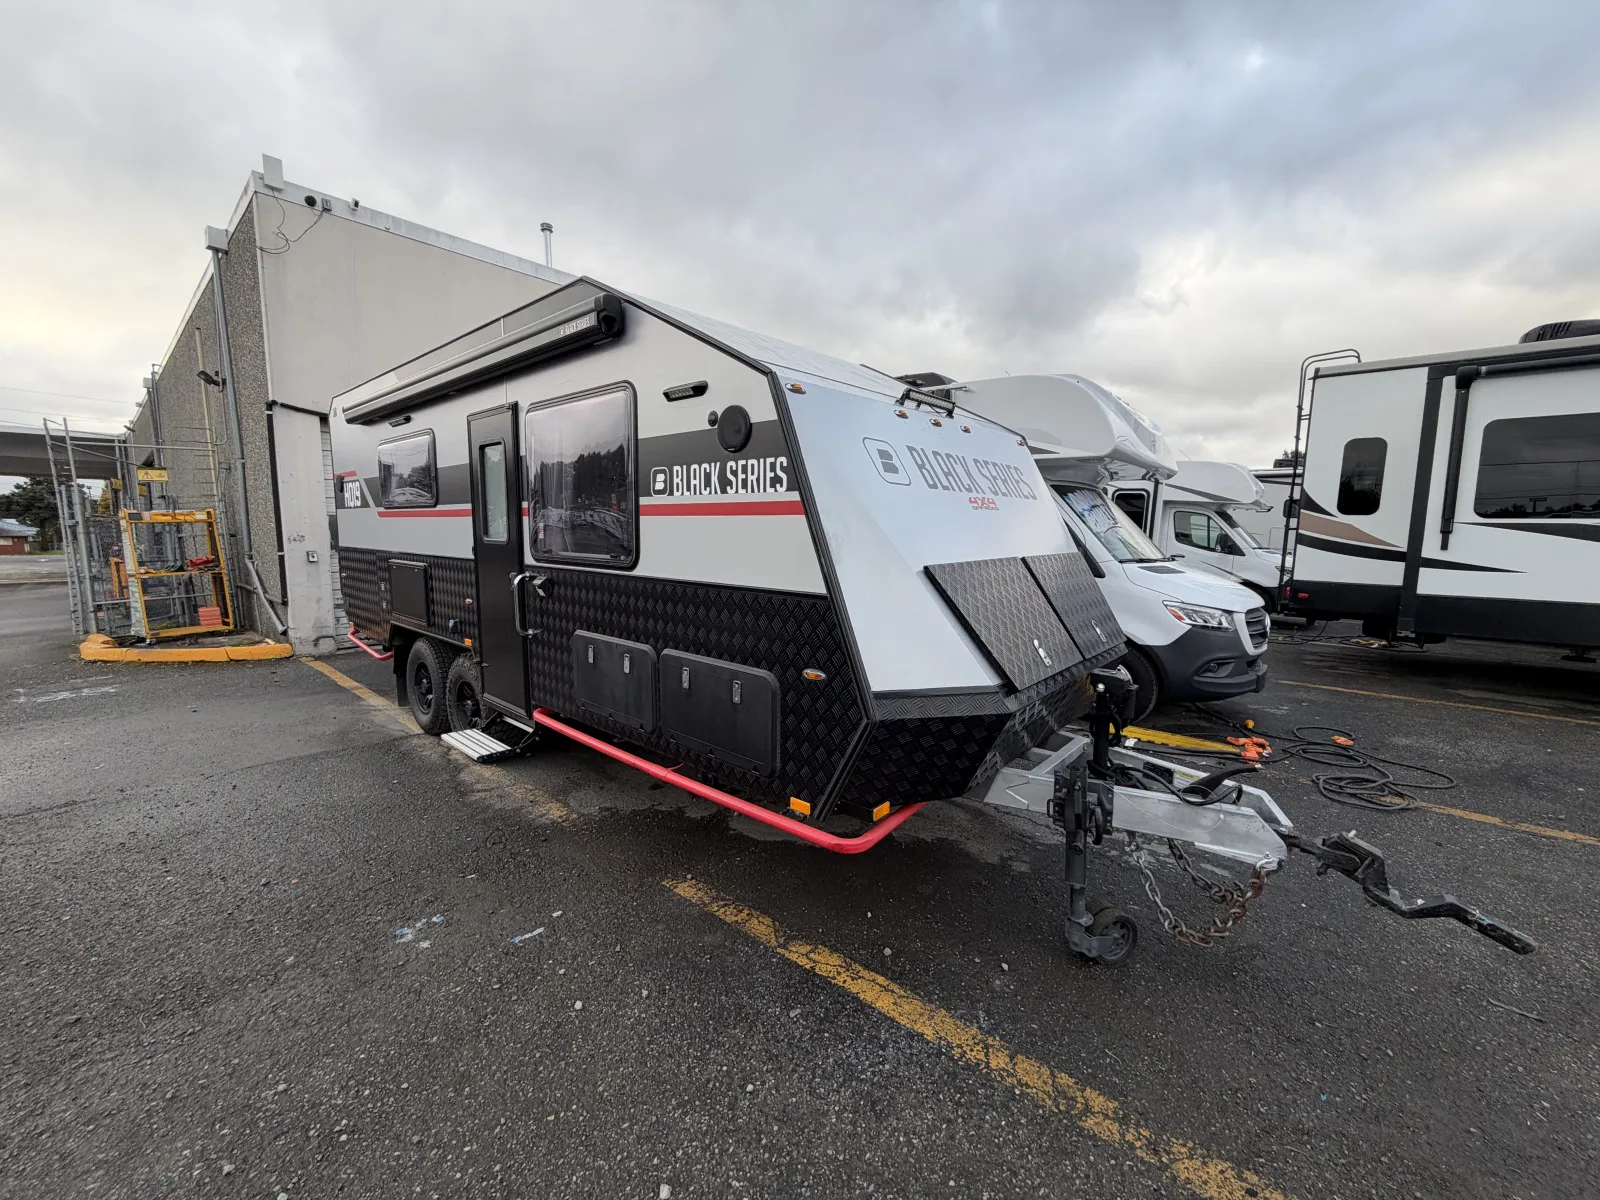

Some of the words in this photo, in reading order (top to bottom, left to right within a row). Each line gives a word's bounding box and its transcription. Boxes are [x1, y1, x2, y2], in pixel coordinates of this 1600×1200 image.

[673, 462, 721, 496] BLACK
[726, 456, 788, 493] SERIES
[905, 444, 986, 494] BLACK
[972, 457, 1038, 500] SERIES
